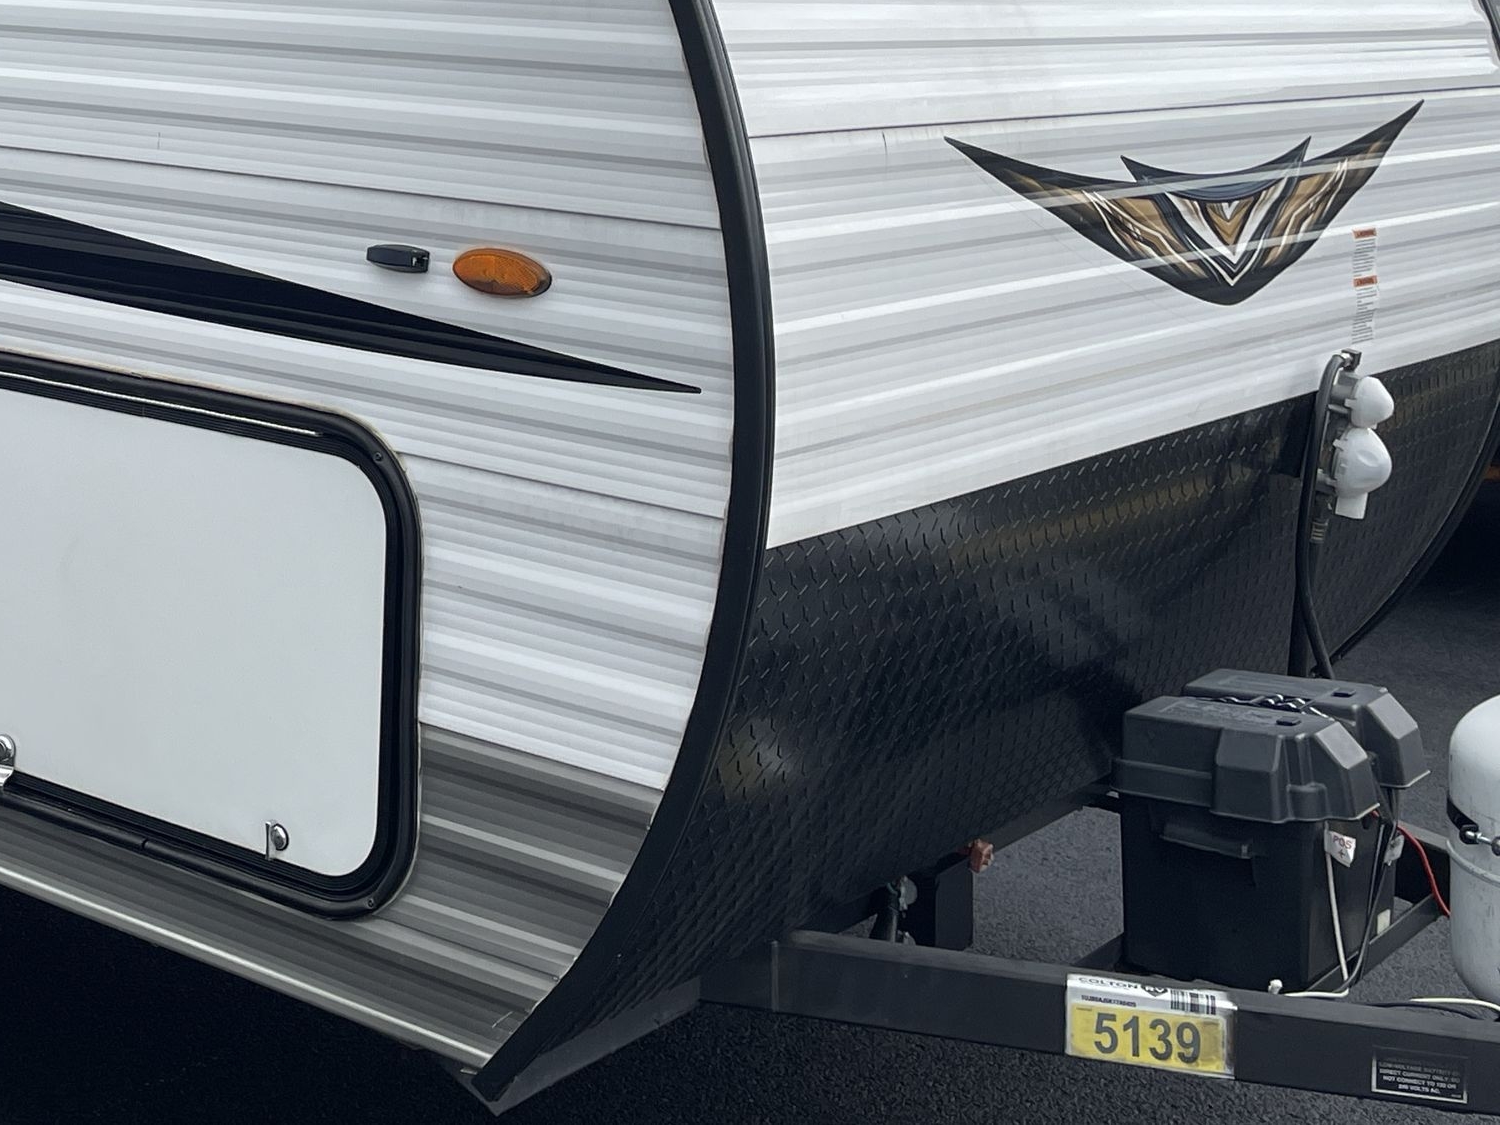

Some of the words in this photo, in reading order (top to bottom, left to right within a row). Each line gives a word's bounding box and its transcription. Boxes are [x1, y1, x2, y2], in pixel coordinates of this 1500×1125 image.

[1332, 835, 1353, 850] POS
[1078, 976, 1139, 990] COLTON
[1094, 1011, 1201, 1064] 5139
